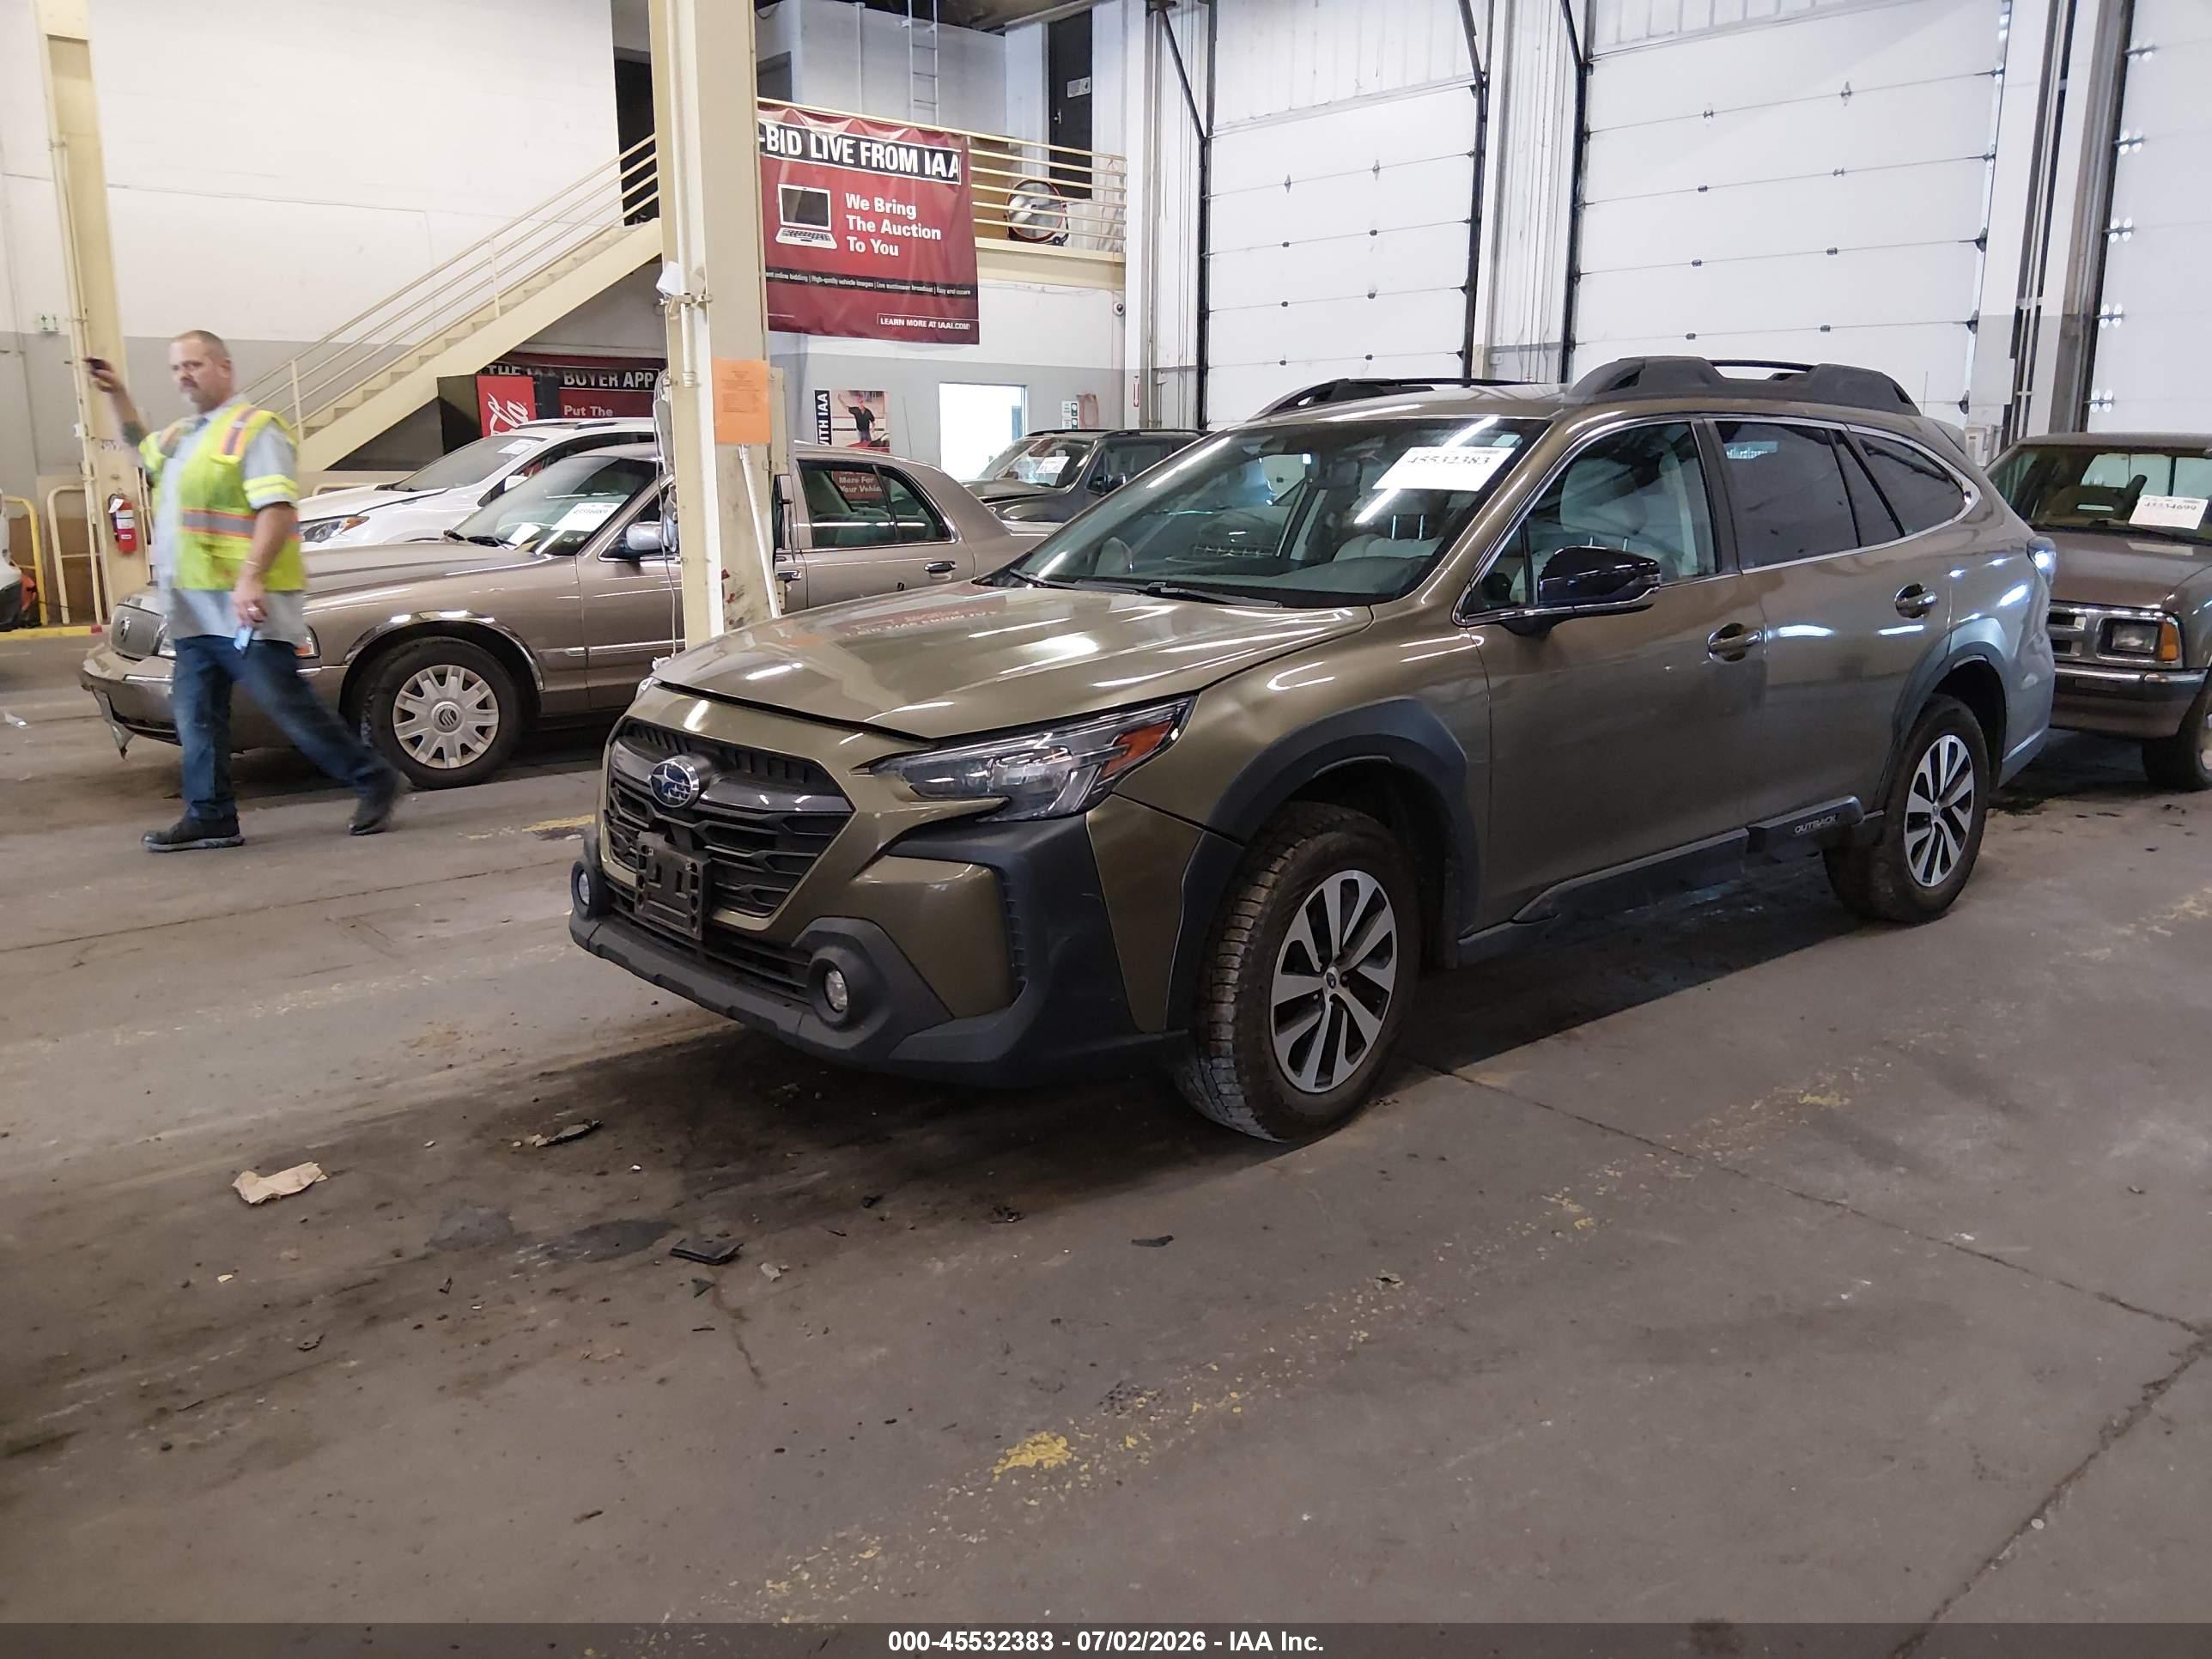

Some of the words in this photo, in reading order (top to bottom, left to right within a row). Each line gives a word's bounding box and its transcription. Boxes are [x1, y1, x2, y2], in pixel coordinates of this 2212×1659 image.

[810, 133, 854, 164] LIVE
[860, 141, 918, 173] FROM
[924, 151, 959, 178] IAA
[845, 192, 870, 211] We
[873, 197, 917, 220] Bring
[846, 215, 876, 233] The
[880, 219, 942, 240] Auction
[846, 235, 866, 252] To
[870, 238, 899, 256] You
[880, 318, 904, 326] LEARN
[906, 319, 927, 328] MORE
[563, 371, 618, 387] BUYER
[623, 371, 654, 388] APP
[563, 404, 586, 416] Put
[589, 405, 613, 416] The
[817, 393, 828, 416] IAA
